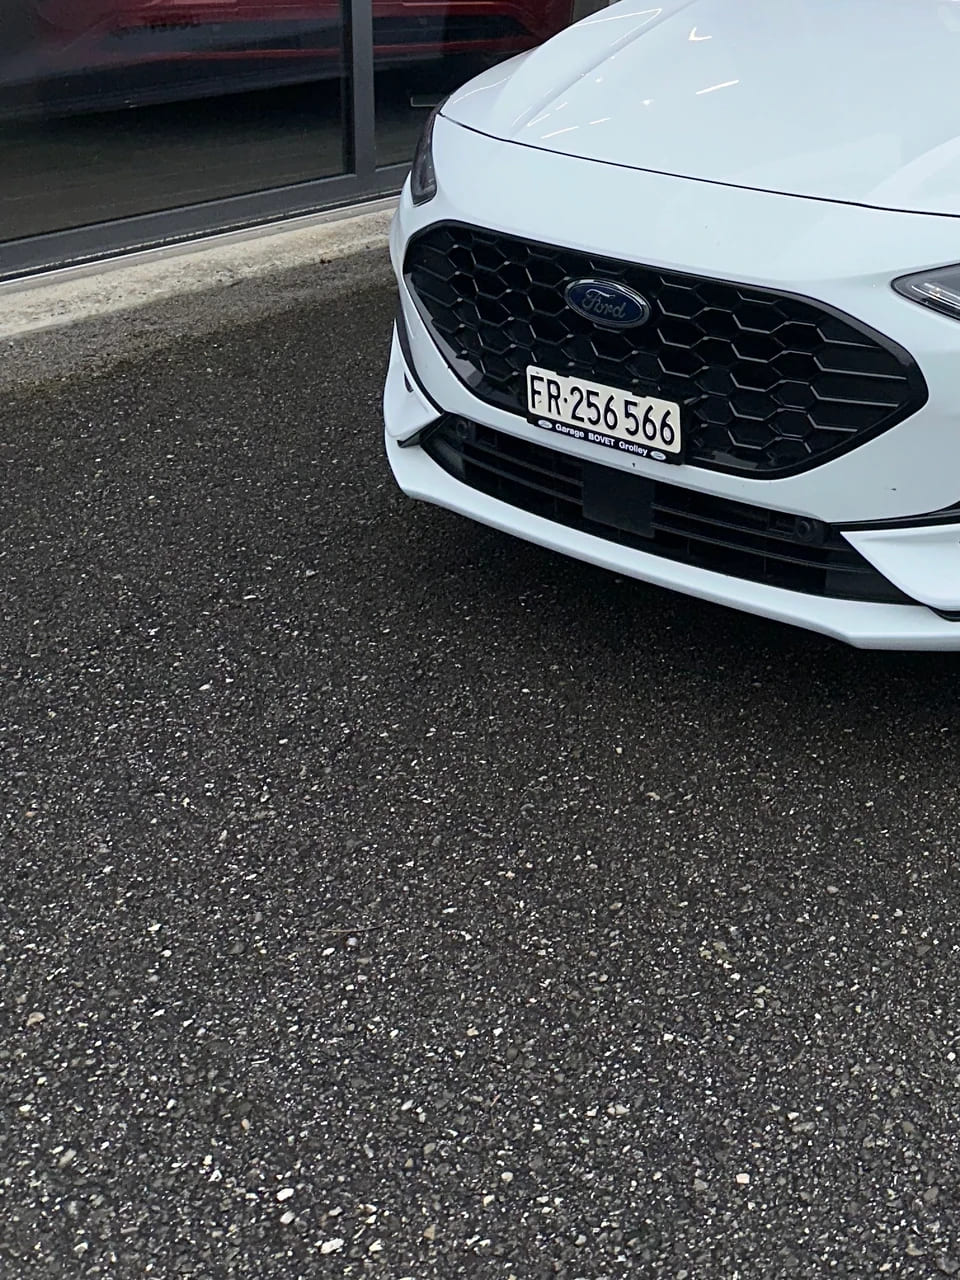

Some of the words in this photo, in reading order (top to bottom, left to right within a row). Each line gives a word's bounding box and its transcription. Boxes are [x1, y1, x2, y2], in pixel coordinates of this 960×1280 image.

[581, 288, 627, 319] Ford
[555, 423, 585, 439] Garage
[588, 432, 616, 447] BOVET
[618, 441, 649, 457] Grolley
